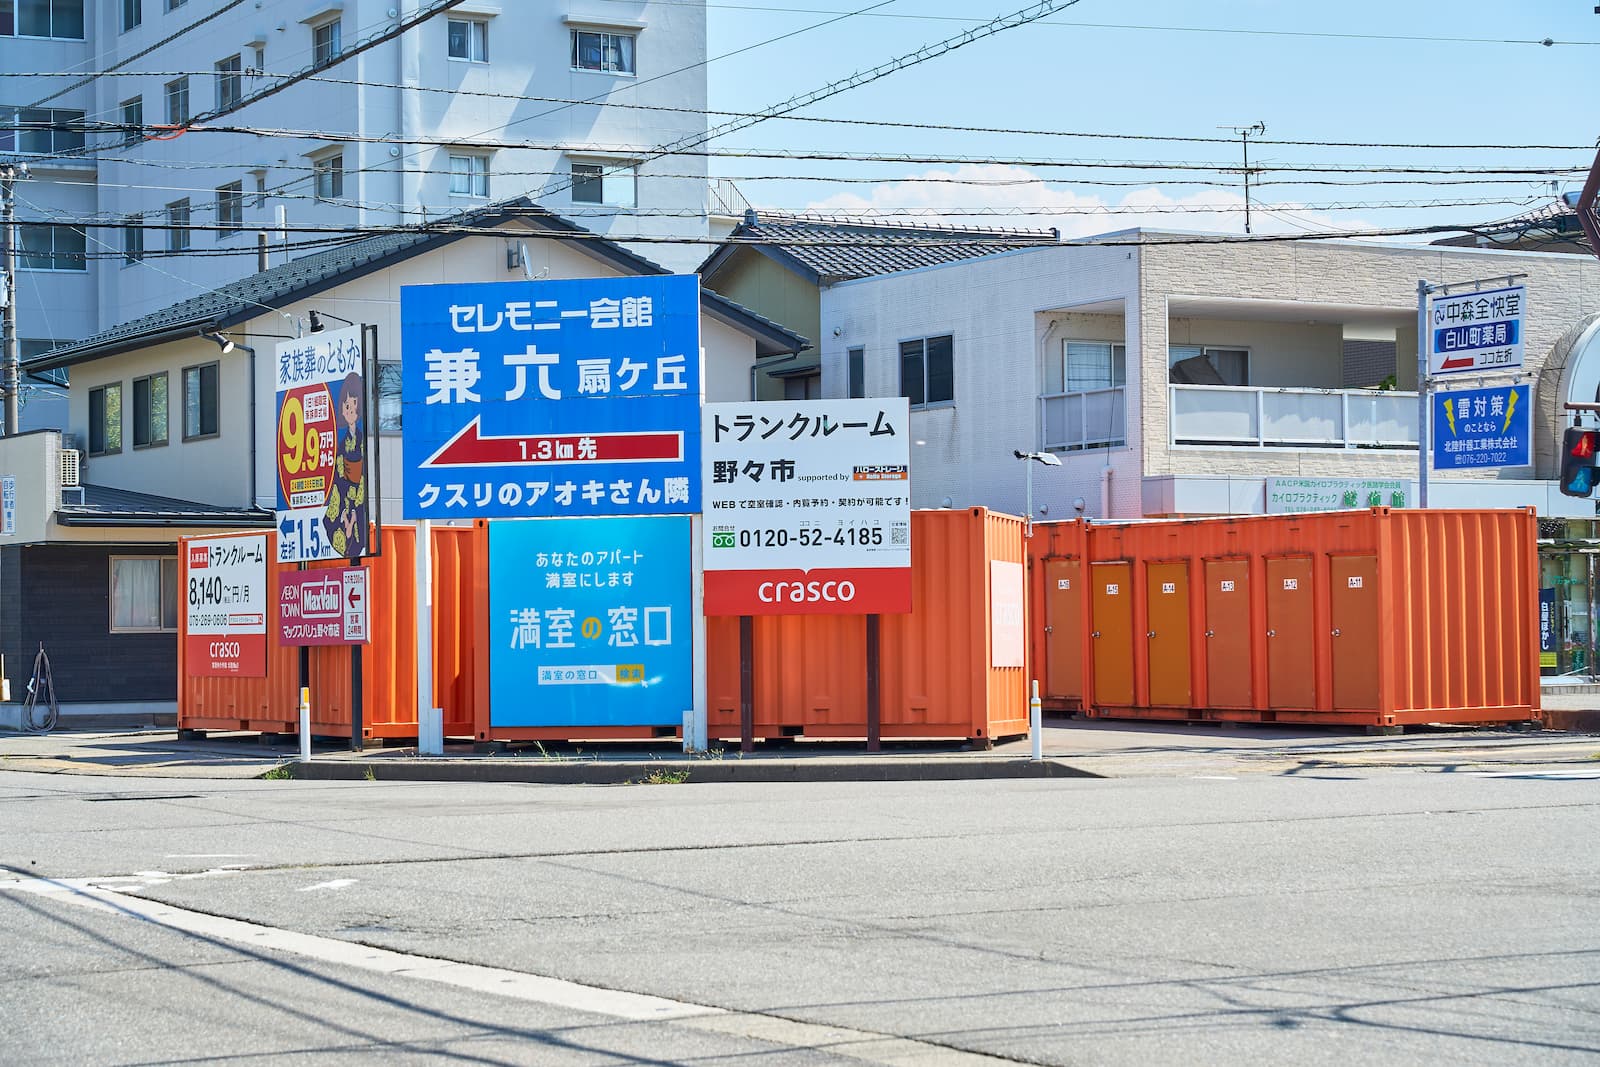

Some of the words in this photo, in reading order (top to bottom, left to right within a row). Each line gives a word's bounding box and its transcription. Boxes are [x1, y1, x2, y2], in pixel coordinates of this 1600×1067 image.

[449, 296, 653, 333] セレモニー会館
[1446, 293, 1520, 324] 中森全快堂
[1445, 324, 1507, 349] 白山町薬局
[280, 338, 360, 384] 家族葬のともか
[1480, 348, 1513, 365] ココ左折
[424, 345, 561, 405] 兼六
[1457, 395, 1504, 420] 雷対策
[714, 411, 896, 443] トランクルーム
[1464, 421, 1497, 433] のことなら
[320, 431, 334, 449] 万円
[320, 450, 334, 467] から
[713, 459, 795, 484] 野々市
[798, 473, 838, 483] supported
[840, 473, 849, 482] by
[418, 477, 689, 508] クスリのアオキさん隣
[1272, 492, 1337, 503] カイロプラクティック
[740, 528, 882, 547] 0120-52-4185
[209, 543, 263, 568] トランクルーム
[281, 541, 295, 560] 左折
[536, 549, 644, 568] あなたのアパート
[545, 571, 634, 588] 満室にします
[304, 577, 338, 611] MaxValu
[758, 581, 855, 602] crasco
[280, 603, 300, 618] TOWN
[282, 623, 340, 638] マックスバリュ野々市店
[510, 605, 672, 650] 満室の窓口
[210, 642, 240, 658] crasco
[542, 669, 598, 681] 満室の窓口
